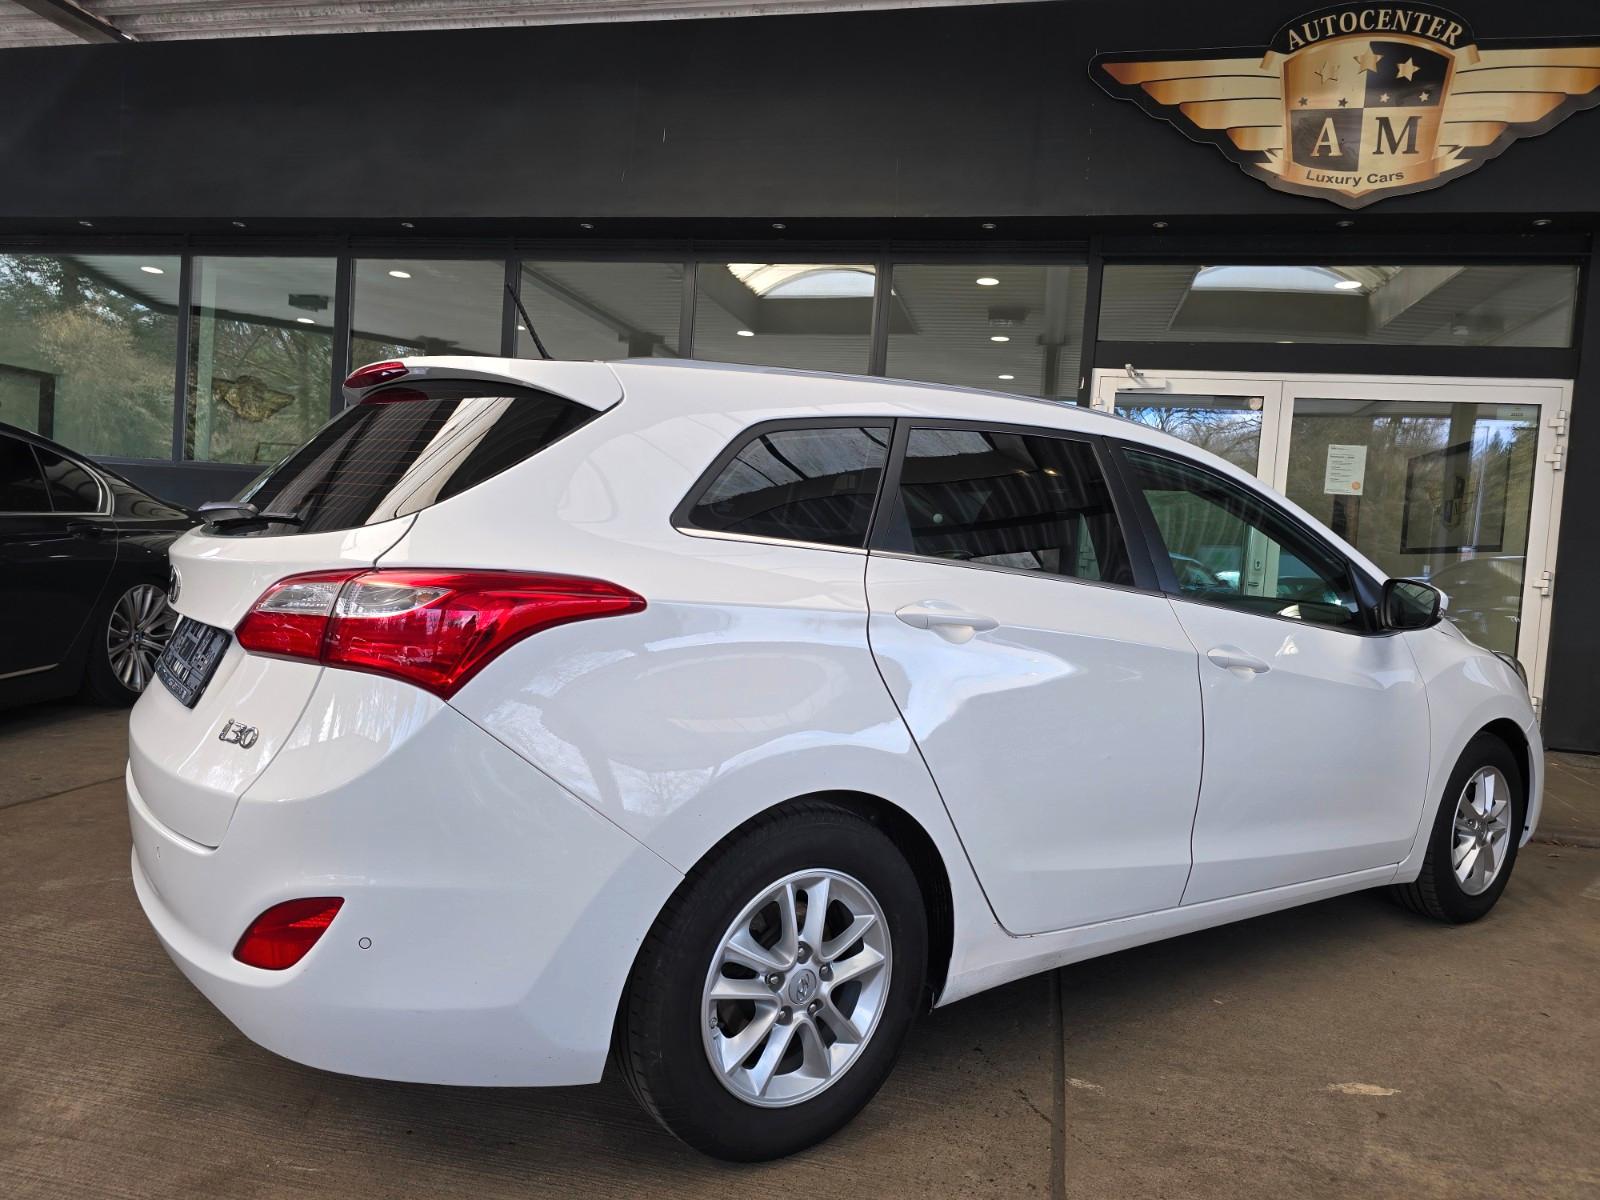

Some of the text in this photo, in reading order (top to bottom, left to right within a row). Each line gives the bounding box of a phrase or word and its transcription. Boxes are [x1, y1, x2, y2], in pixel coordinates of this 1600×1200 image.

[1288, 9, 1463, 50] AUTOCENTER
[1310, 115, 1423, 157] A M
[1306, 169, 1405, 187] Luxury Cars
[218, 718, 259, 749] i30
